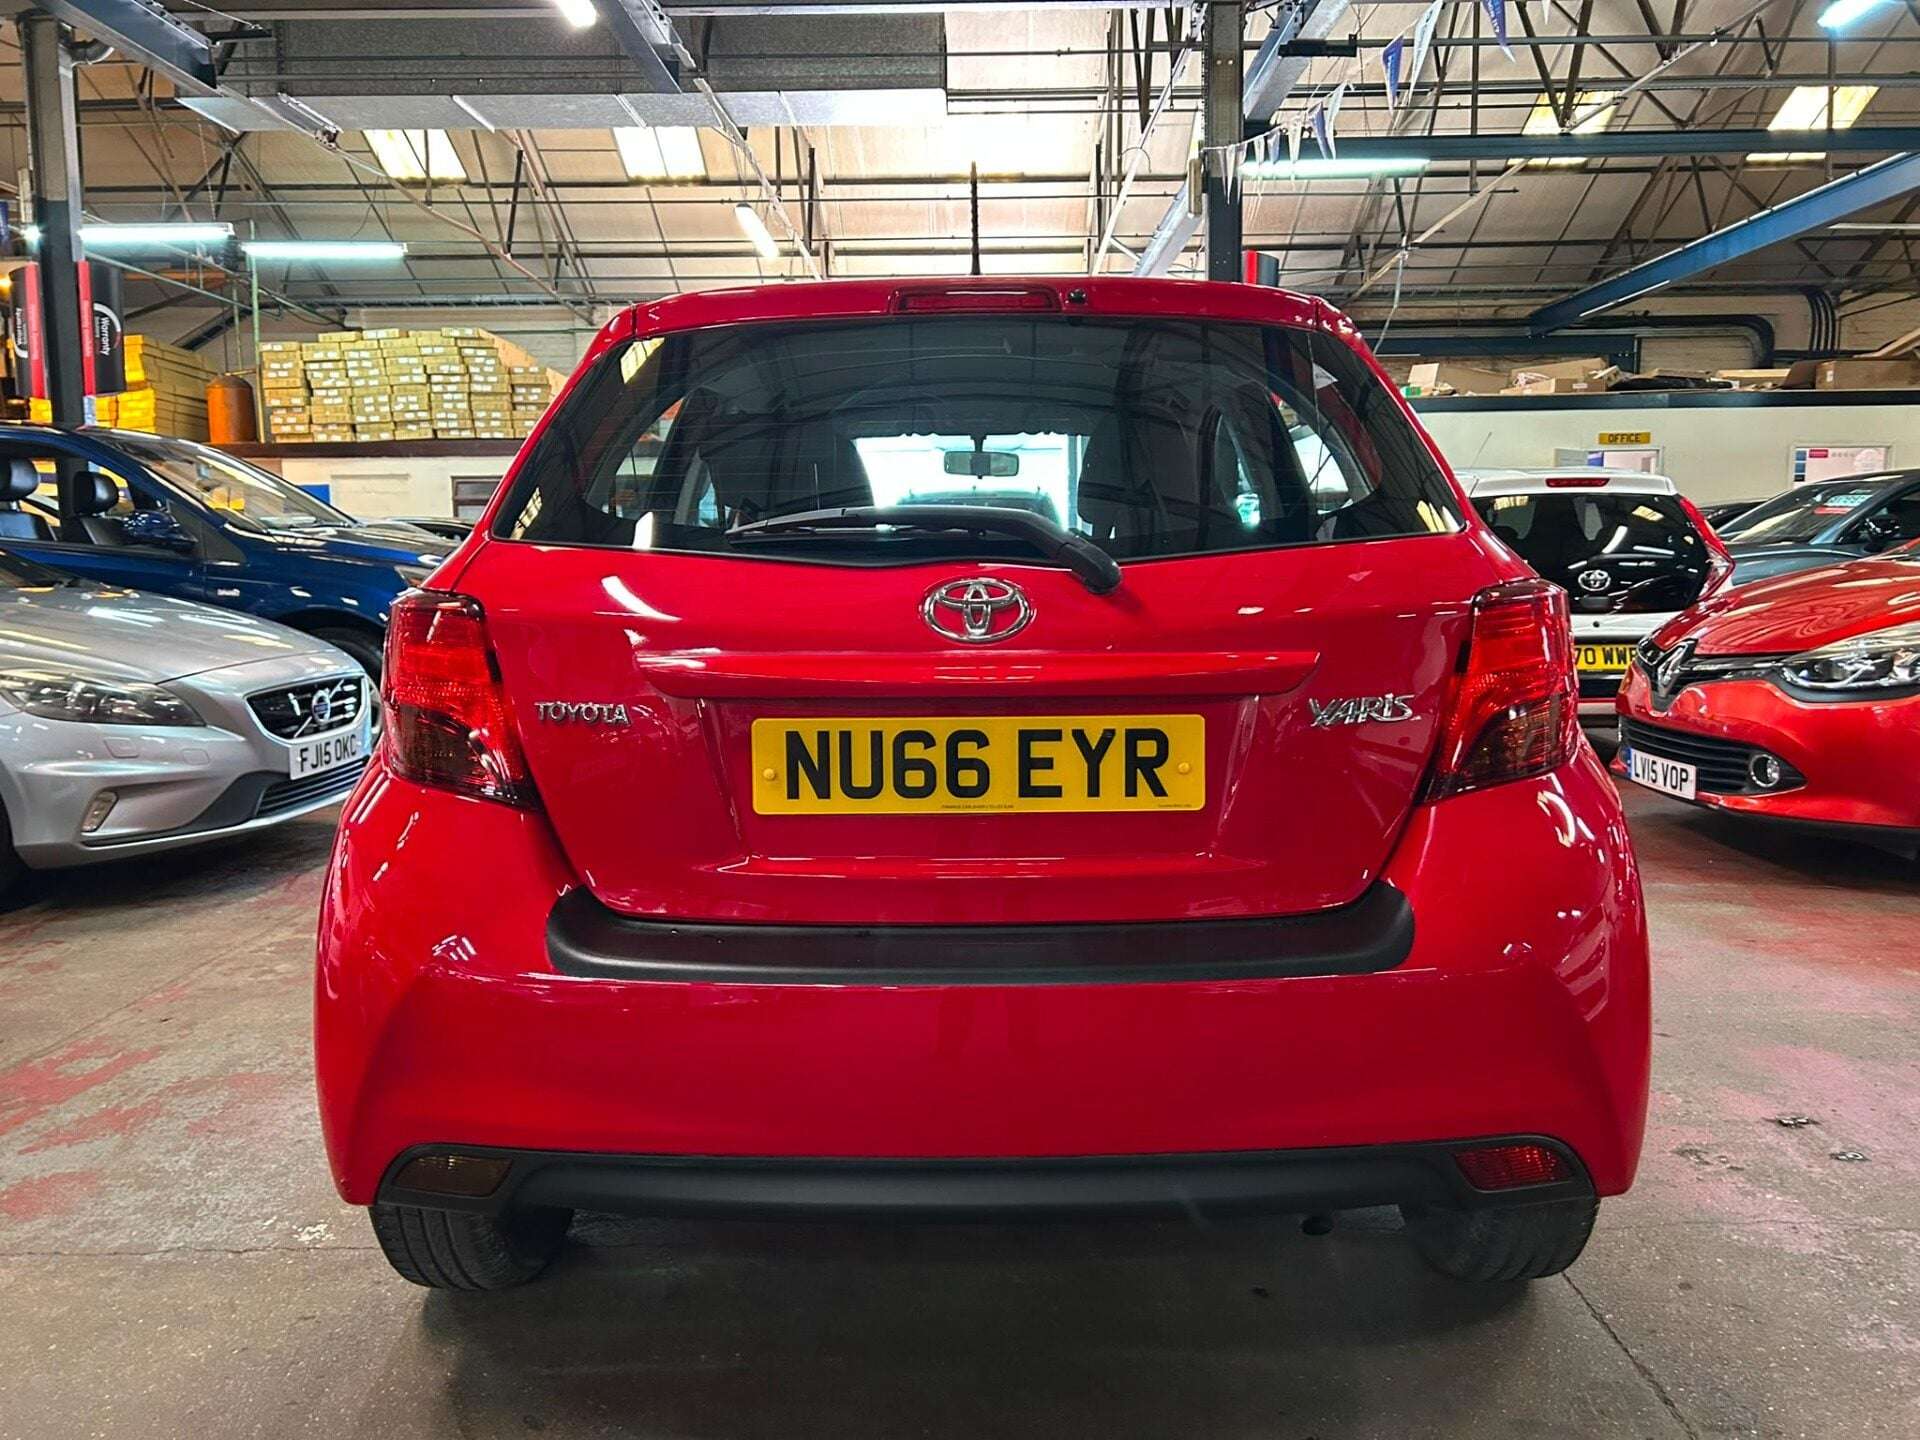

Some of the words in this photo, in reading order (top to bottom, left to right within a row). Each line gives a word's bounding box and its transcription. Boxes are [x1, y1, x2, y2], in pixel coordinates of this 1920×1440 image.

[99, 316, 110, 356] Warranty
[1607, 432, 1641, 443] OFFICE
[534, 701, 631, 726] TOYOTA
[1308, 693, 1421, 729] YARIS
[300, 742, 332, 772] FJ15
[334, 734, 357, 761] OKC
[785, 729, 990, 800] NU66
[1018, 728, 1169, 798] EYR
[1634, 753, 1658, 783] LV15
[1662, 762, 1689, 792] VOP
